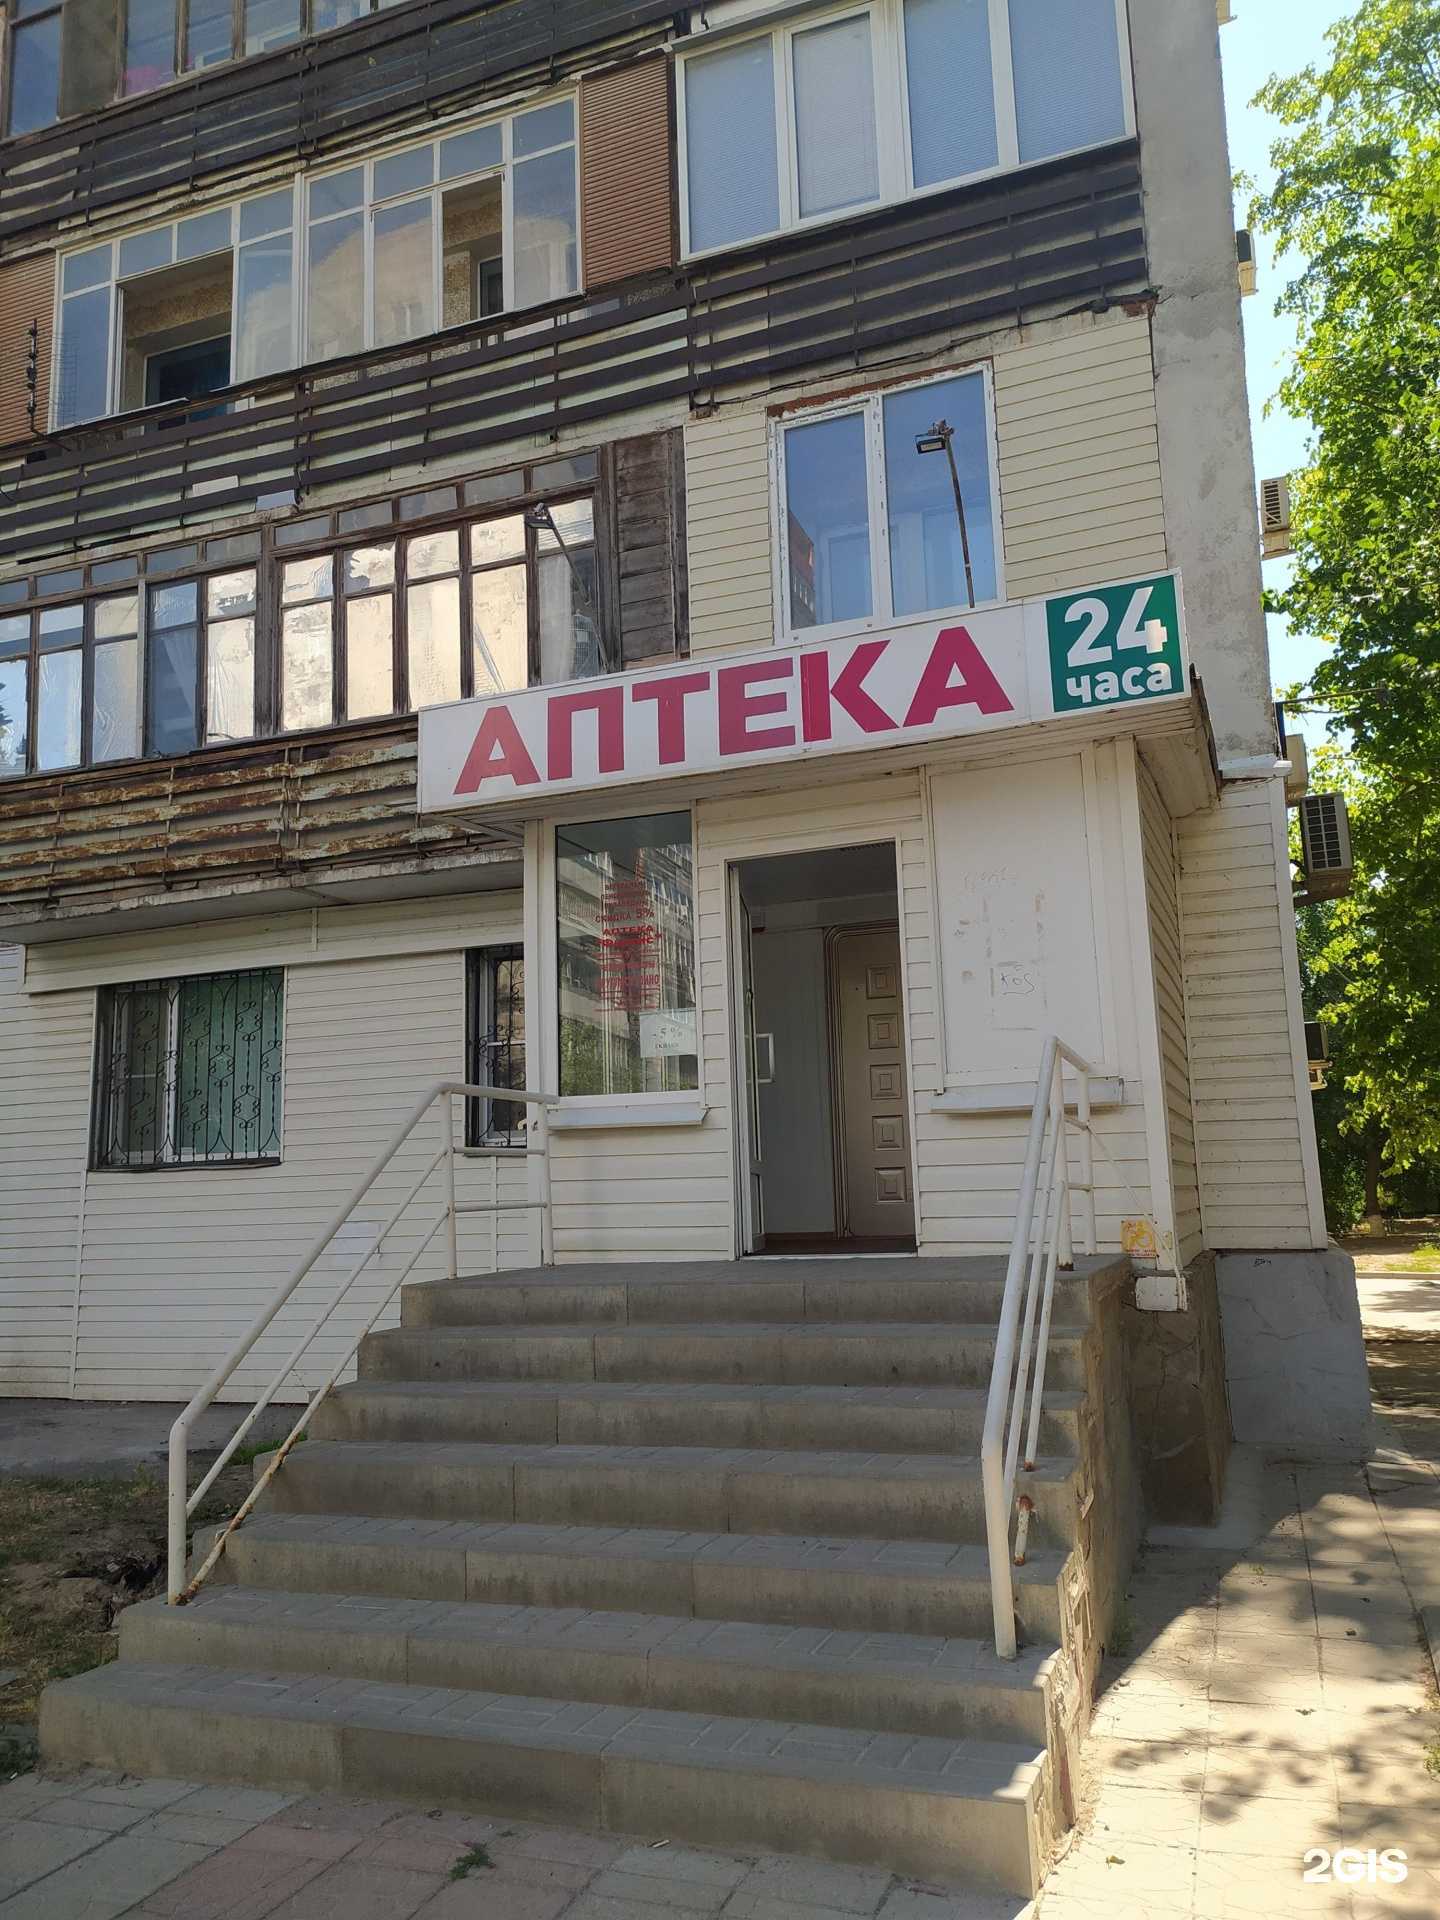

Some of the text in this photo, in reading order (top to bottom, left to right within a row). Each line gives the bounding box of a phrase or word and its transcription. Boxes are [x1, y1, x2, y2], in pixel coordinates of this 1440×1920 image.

[1064, 586, 1167, 667] 24
[454, 626, 1014, 795] АПТЕКА
[1066, 662, 1172, 703] часа
